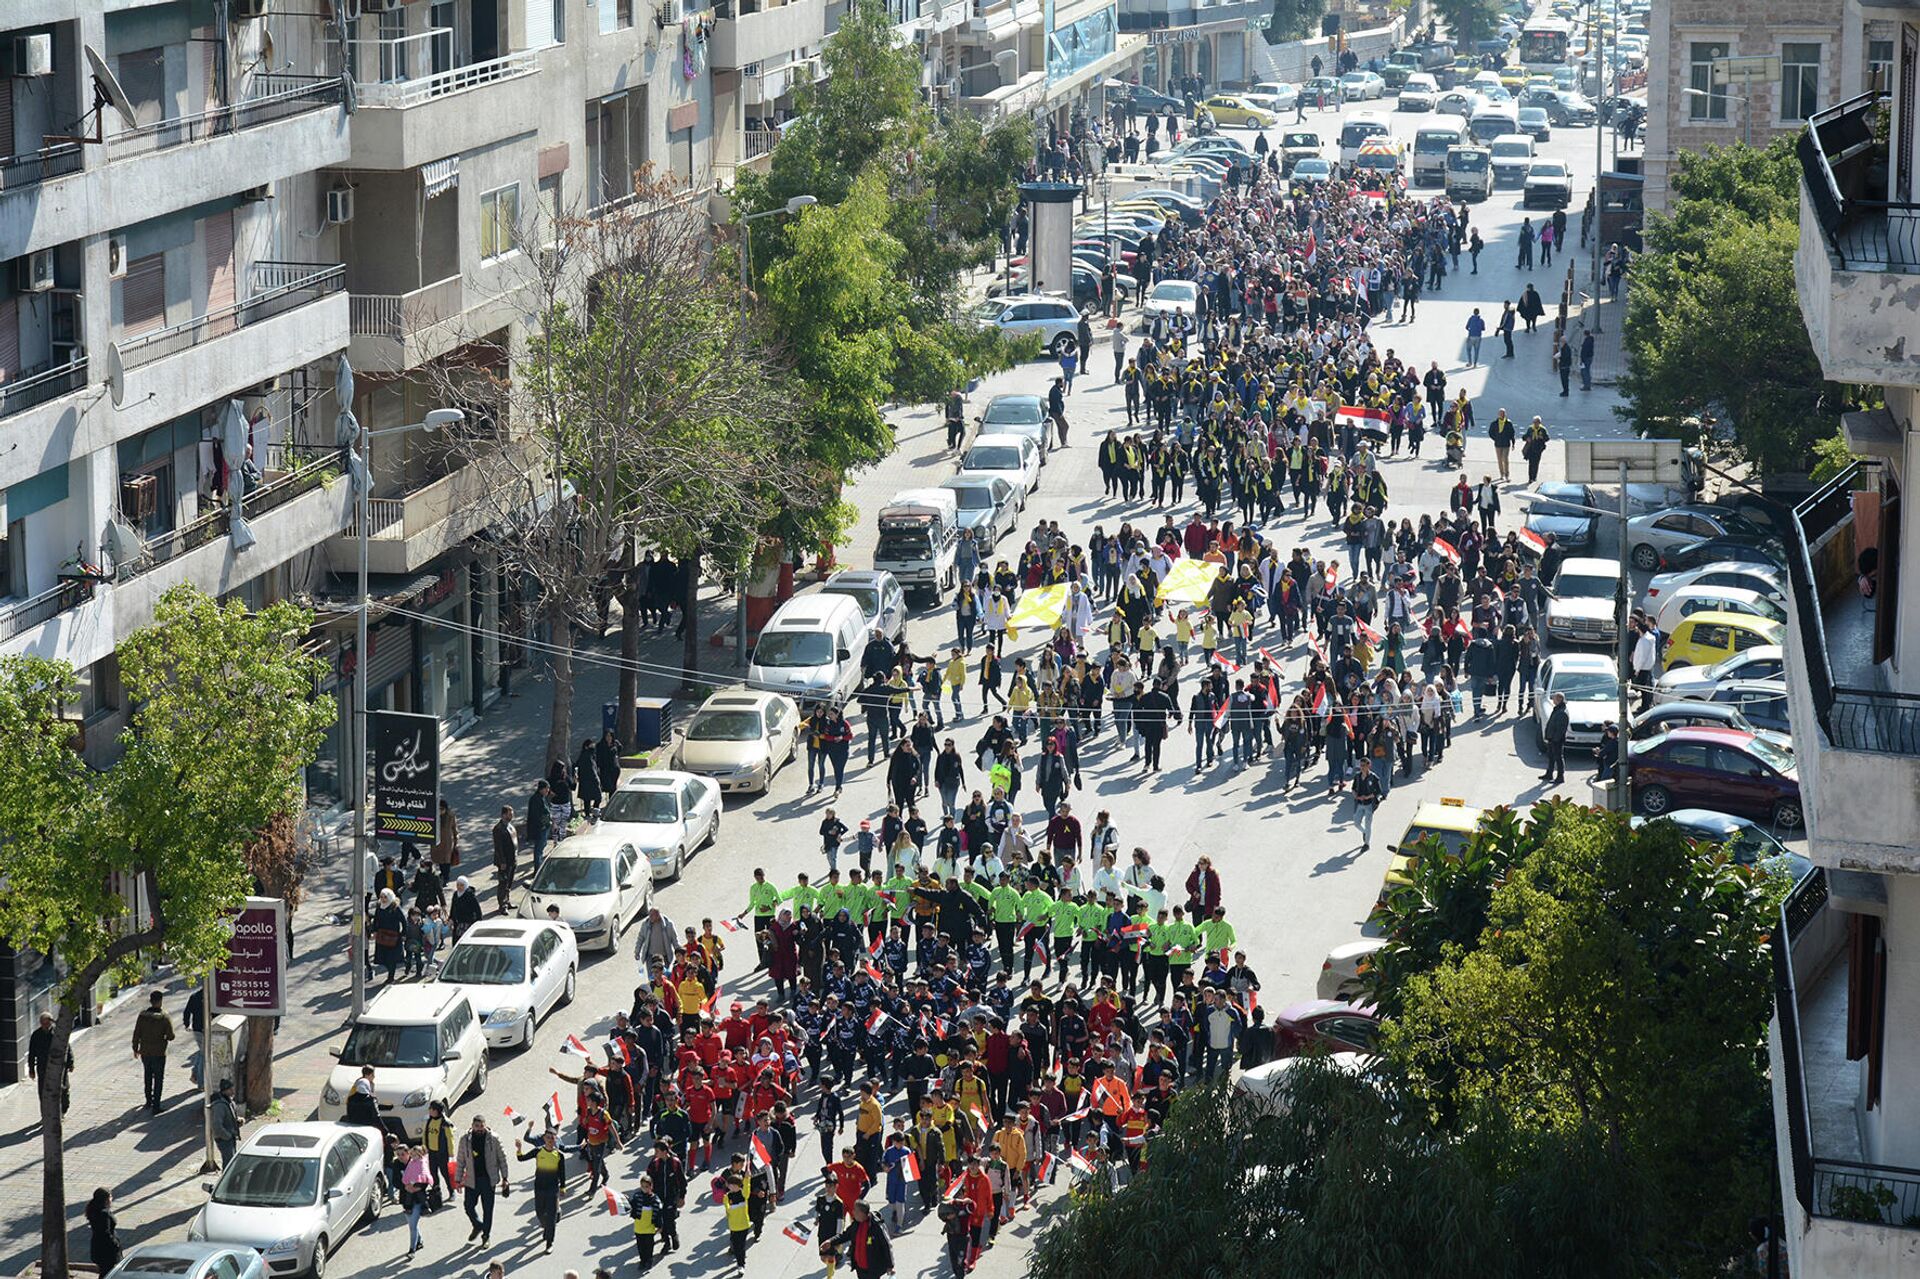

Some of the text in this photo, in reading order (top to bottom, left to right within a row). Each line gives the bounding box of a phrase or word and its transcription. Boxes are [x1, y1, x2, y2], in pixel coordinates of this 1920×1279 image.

[236, 923, 273, 935] apollo
[231, 980, 270, 988] 2551515
[231, 989, 270, 997] 2551592
